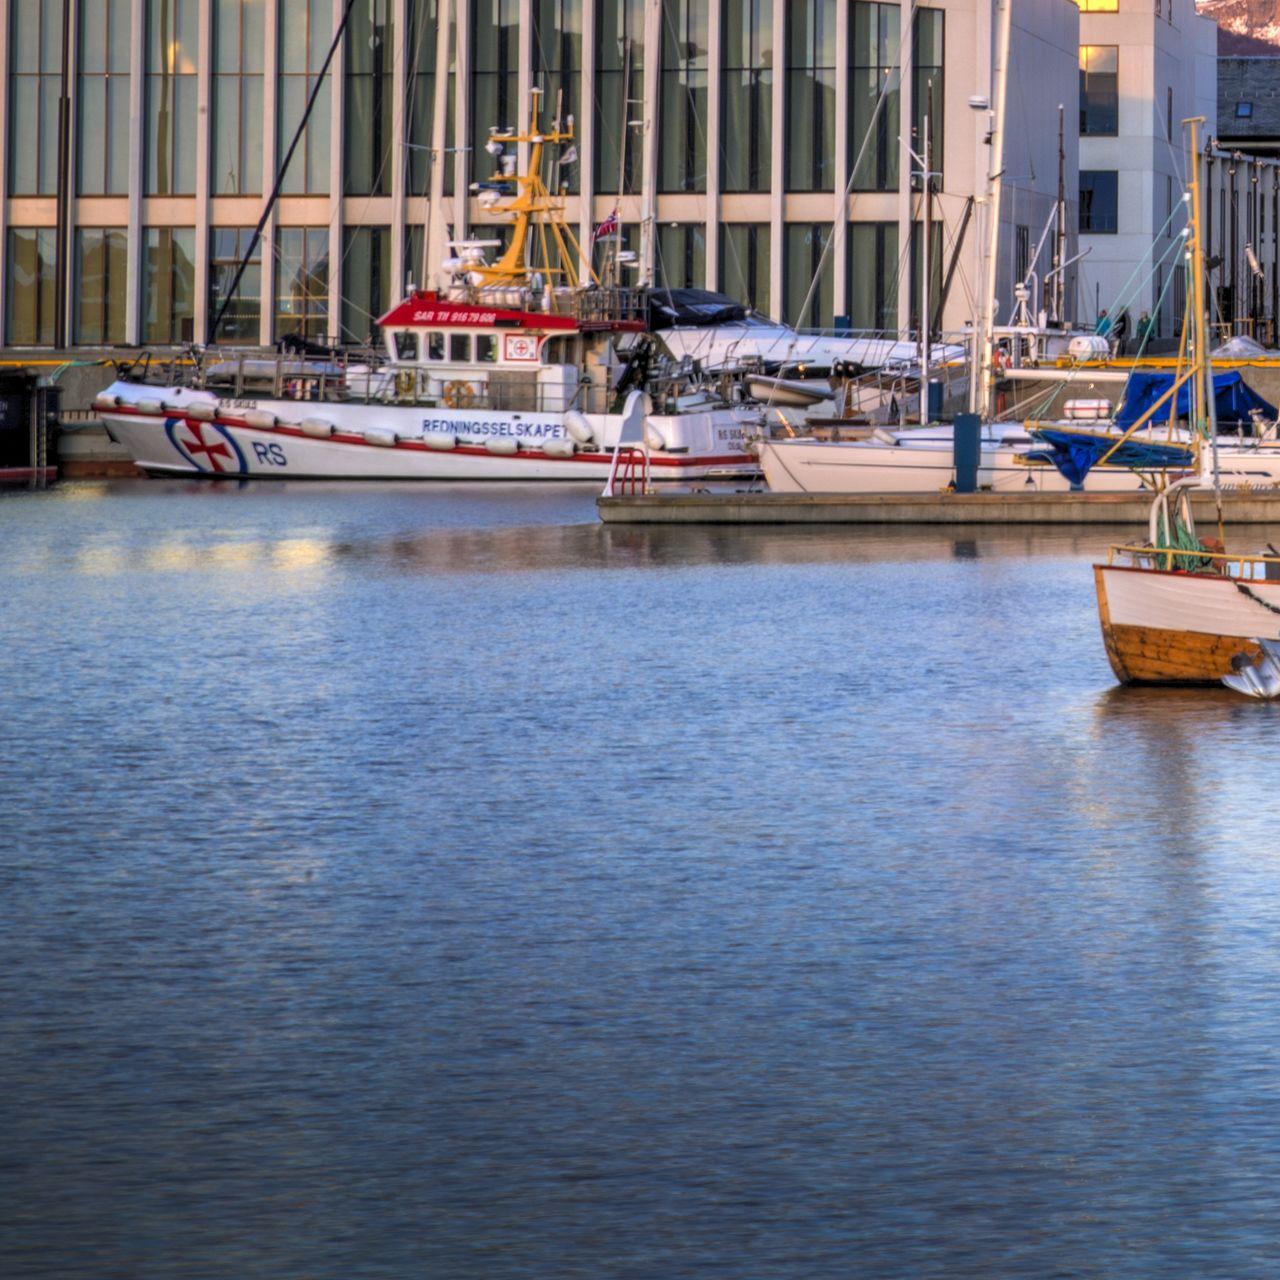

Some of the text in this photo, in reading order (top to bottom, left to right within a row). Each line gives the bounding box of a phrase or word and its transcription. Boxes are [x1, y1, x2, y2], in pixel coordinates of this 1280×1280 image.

[412, 310, 434, 321] SAR
[422, 419, 569, 439] REDNINGSSELSKAPET
[251, 440, 288, 467] RS
